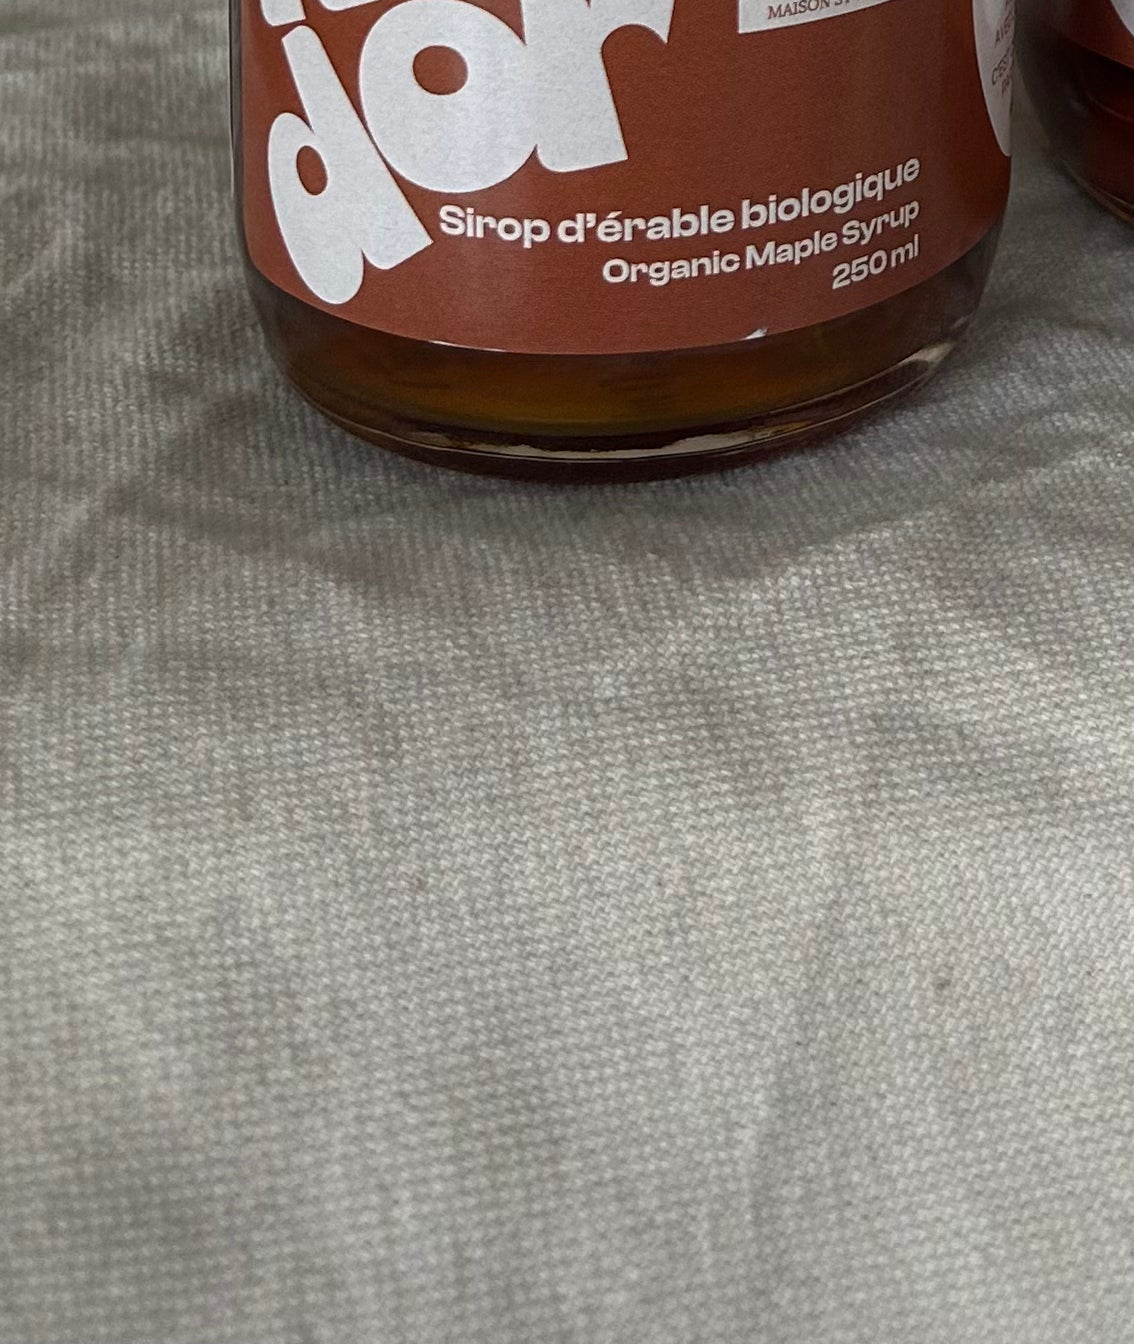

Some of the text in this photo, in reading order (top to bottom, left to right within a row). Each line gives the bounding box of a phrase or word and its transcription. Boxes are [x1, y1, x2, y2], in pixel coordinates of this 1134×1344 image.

[439, 204, 551, 250] Sirop
[741, 157, 920, 230] biologique
[602, 200, 919, 287] Organic Maple Syrup
[832, 233, 920, 290] 250 ml
